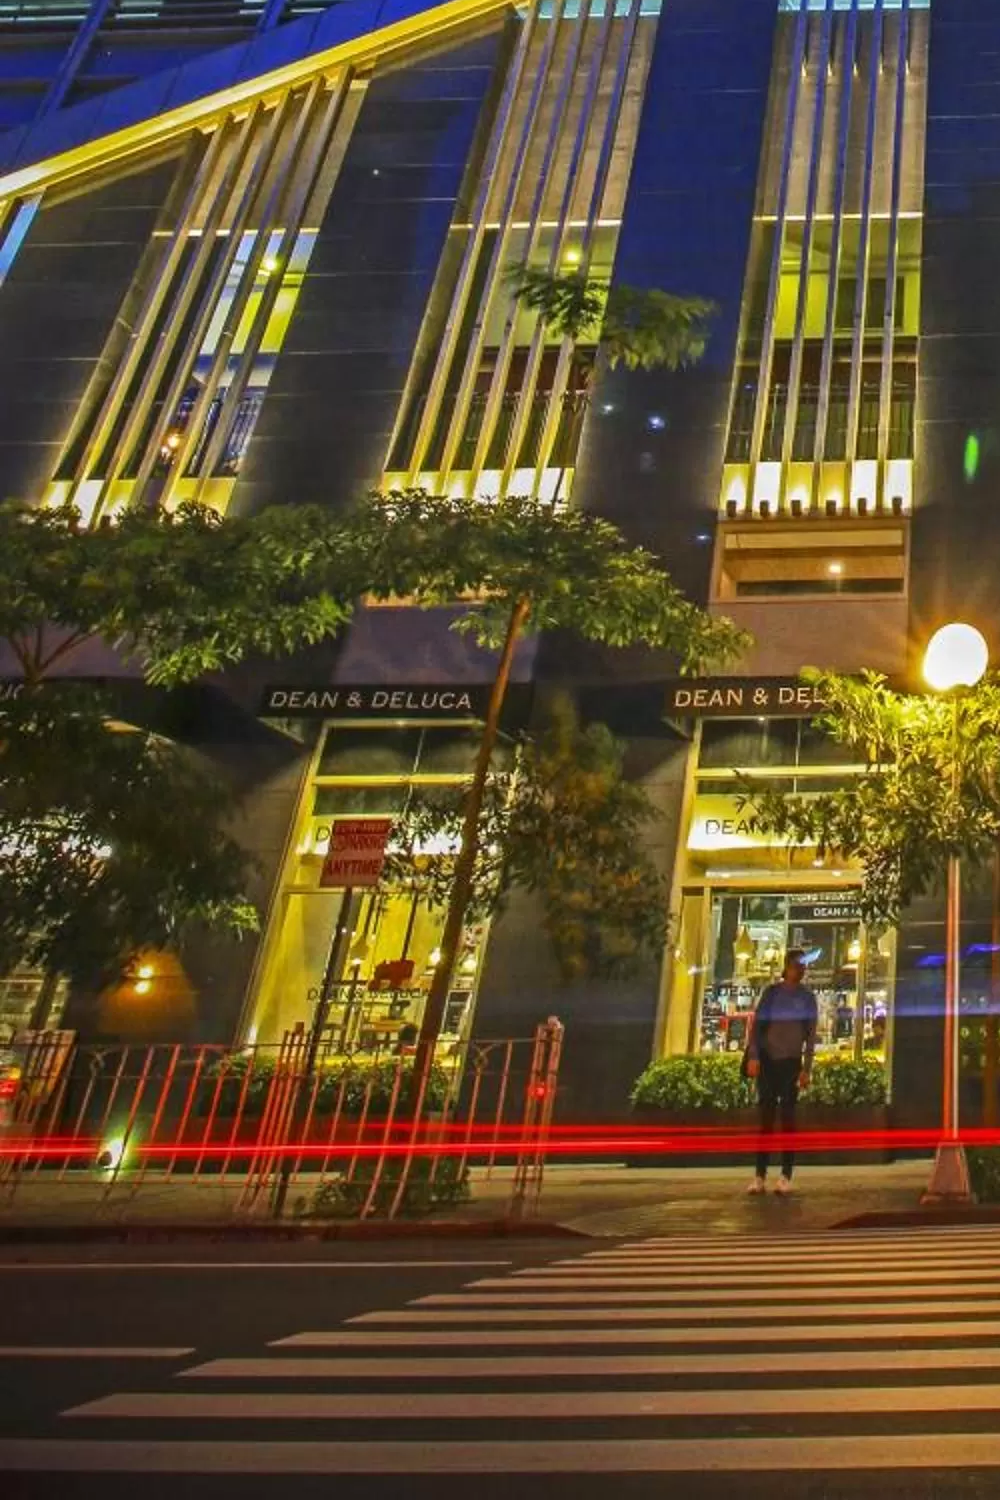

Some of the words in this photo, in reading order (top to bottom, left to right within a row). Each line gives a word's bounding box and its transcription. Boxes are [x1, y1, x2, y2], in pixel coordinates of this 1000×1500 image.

[270, 691, 339, 708] DEAN
[347, 691, 362, 708] &
[371, 691, 471, 708] DELUCA
[674, 689, 743, 707] DEAN
[753, 687, 769, 705] &
[705, 819, 768, 836] DEAN
